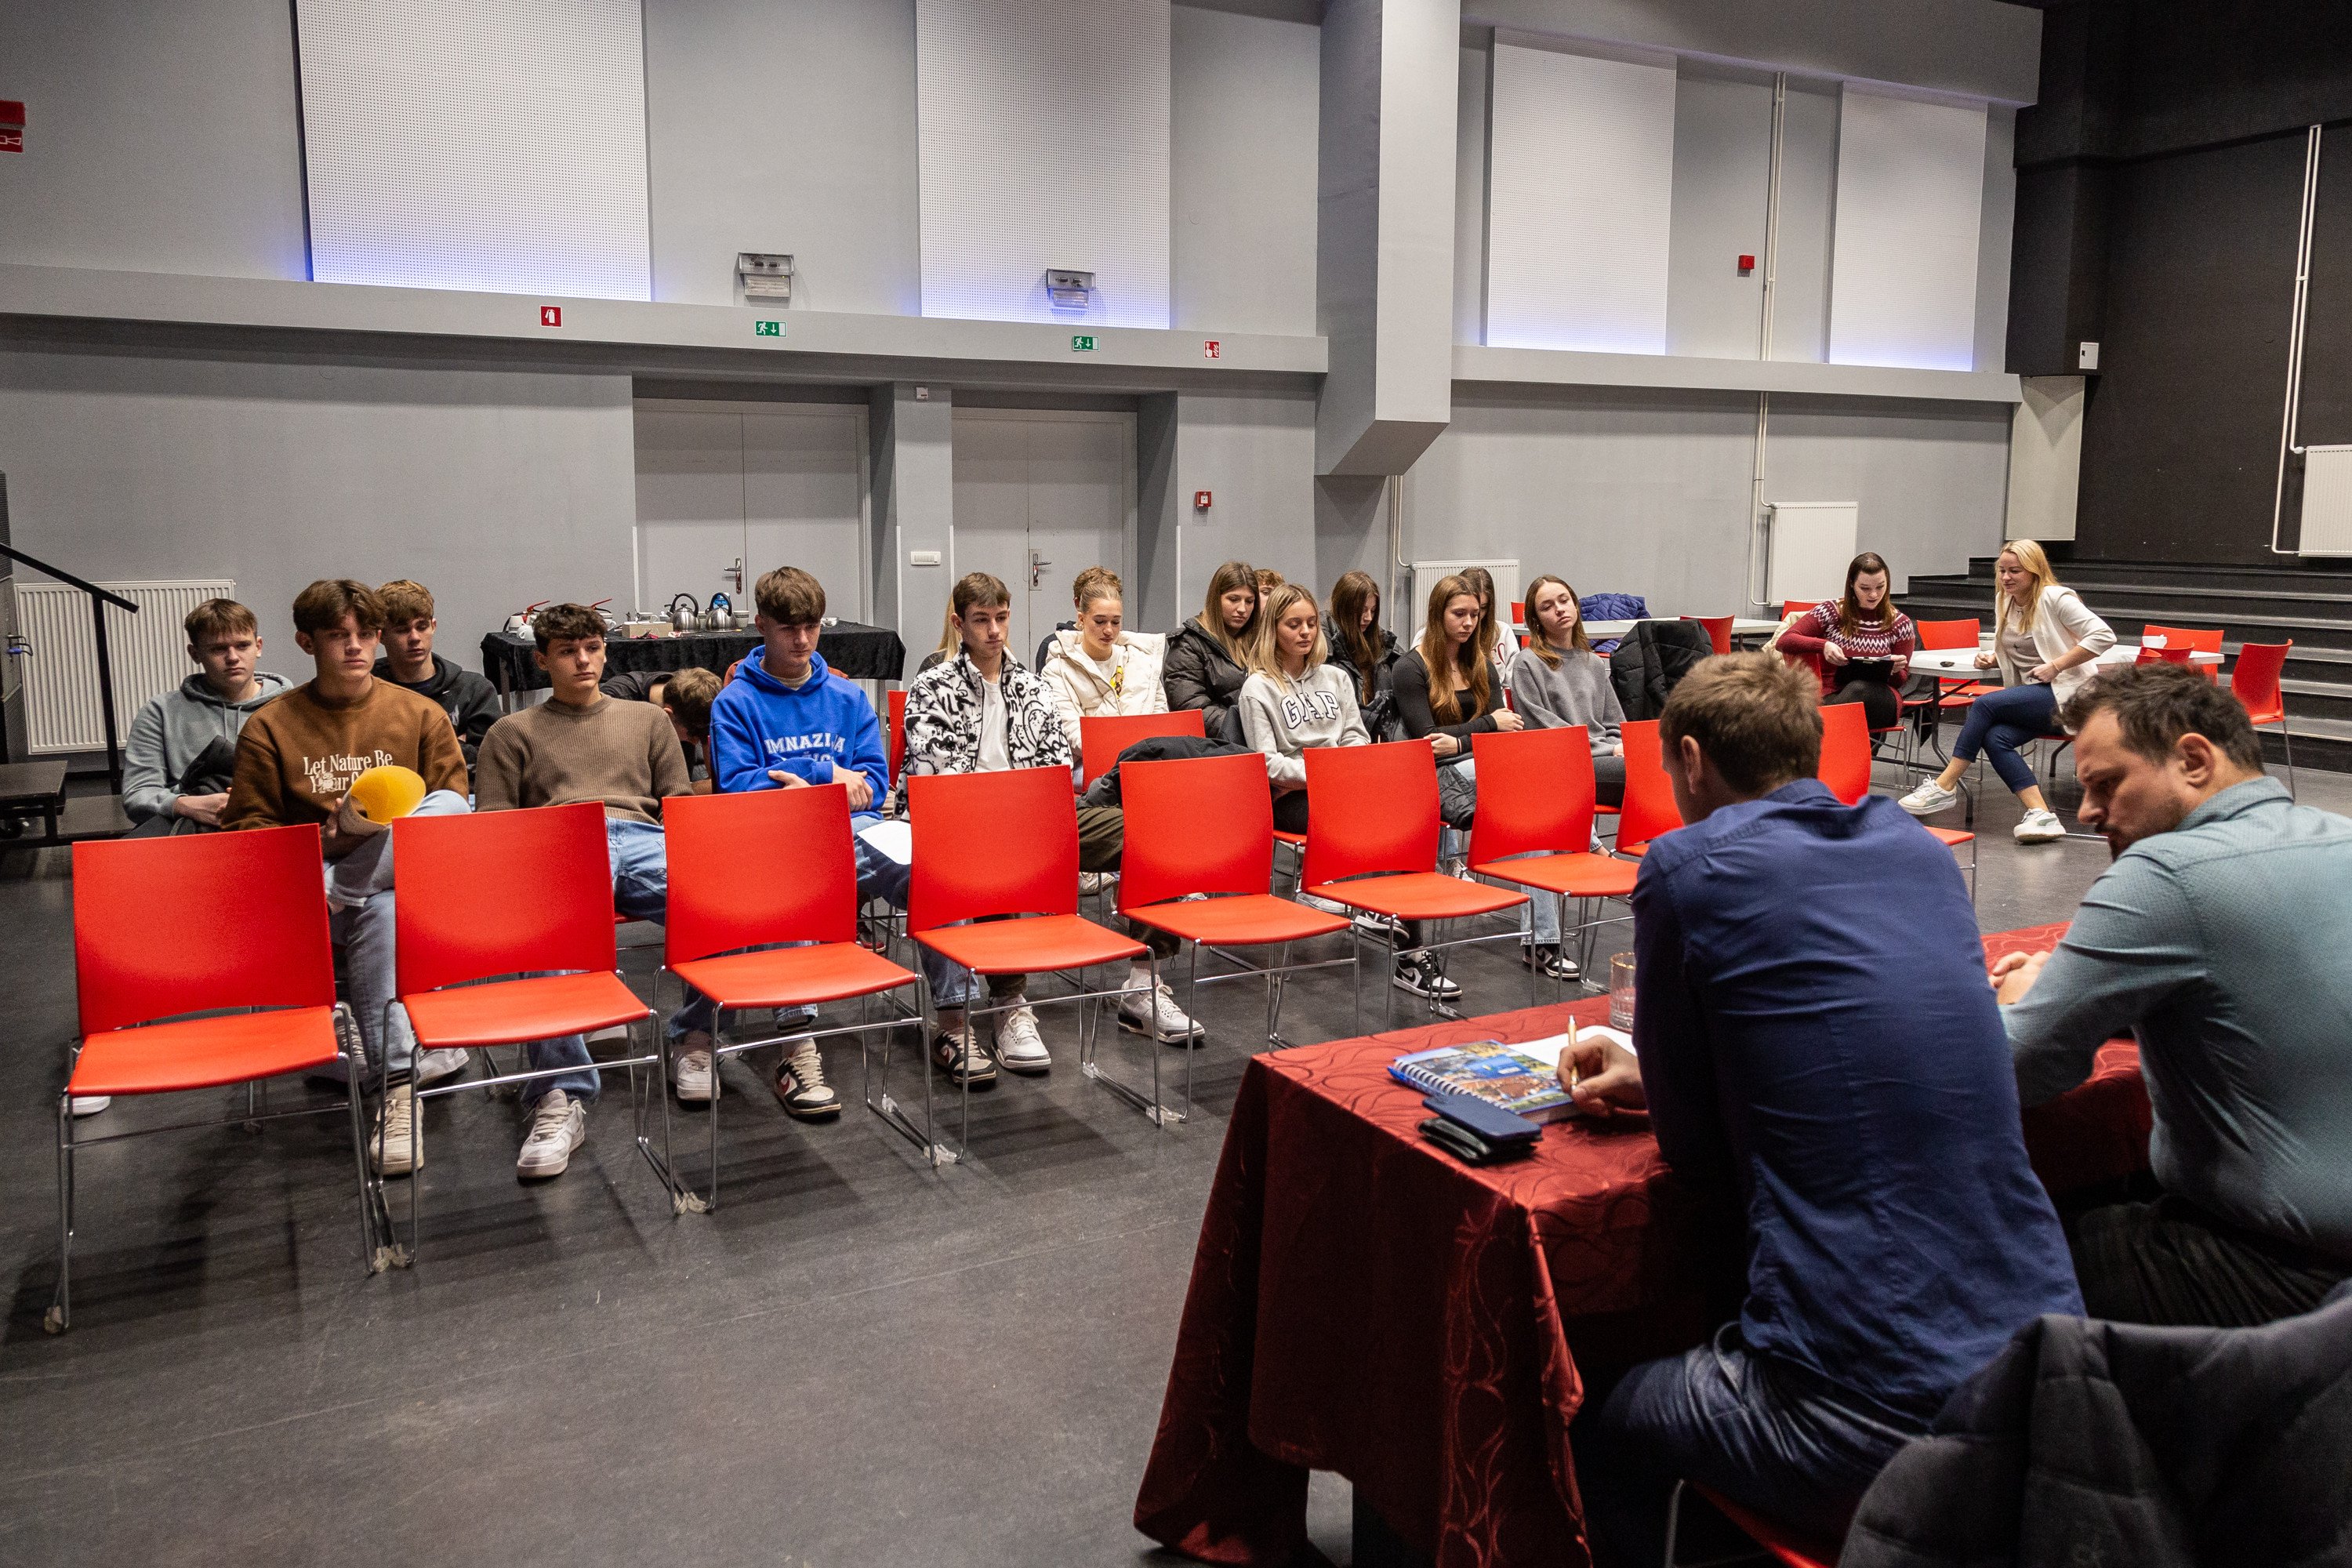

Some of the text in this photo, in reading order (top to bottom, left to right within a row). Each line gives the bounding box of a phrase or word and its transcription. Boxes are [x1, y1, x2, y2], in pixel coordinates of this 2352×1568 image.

[1280, 691, 1338, 730] GAP
[303, 750, 394, 775] Let Nature Be
